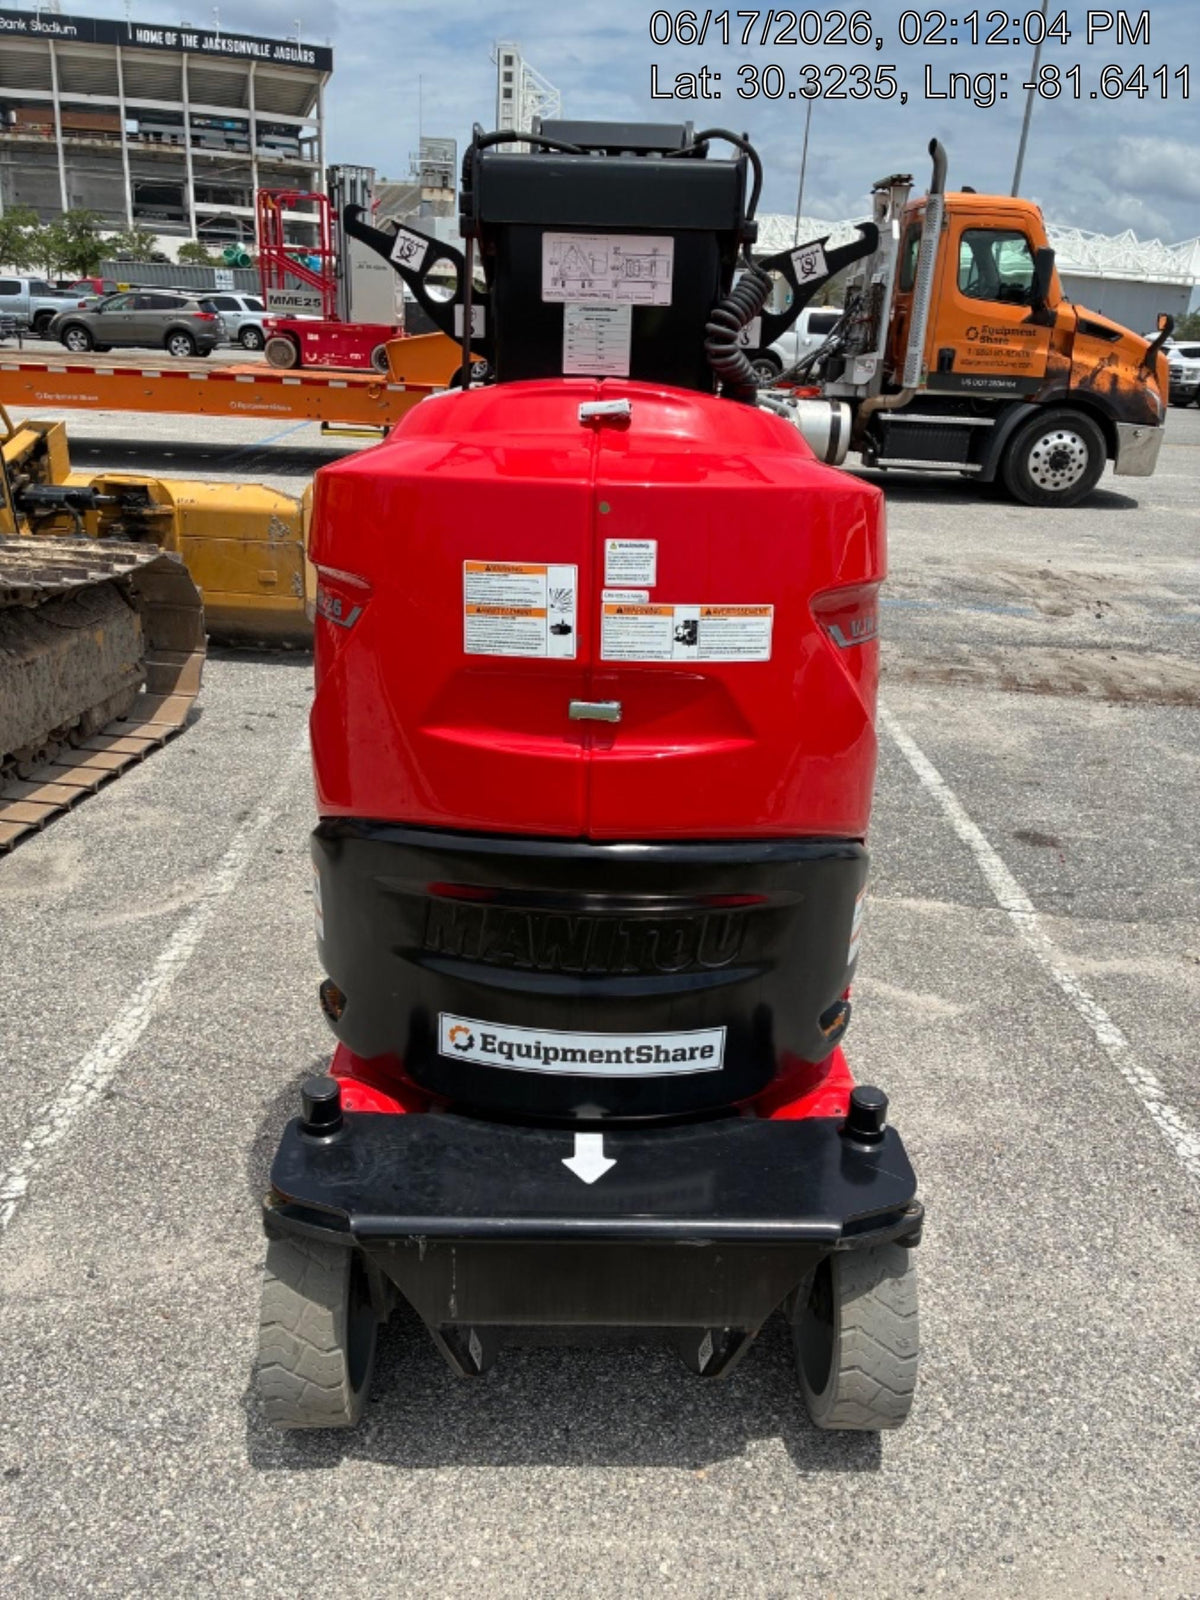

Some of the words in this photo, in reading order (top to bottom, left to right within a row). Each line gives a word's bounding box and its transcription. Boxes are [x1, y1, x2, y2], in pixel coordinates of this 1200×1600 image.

[30, 19, 77, 35] Stadium
[136, 29, 163, 45] HOME
[165, 33, 177, 46] OF
[180, 34, 199, 48] THE
[202, 36, 271, 58] JACKSONVILLE
[273, 46, 315, 64] JAGUARS
[269, 294, 321, 308] MME25
[981, 325, 1037, 337] Equipment
[980, 336, 1009, 344] Share
[423, 899, 747, 972] MANITOU
[480, 1032, 715, 1065] EquipmentShare
